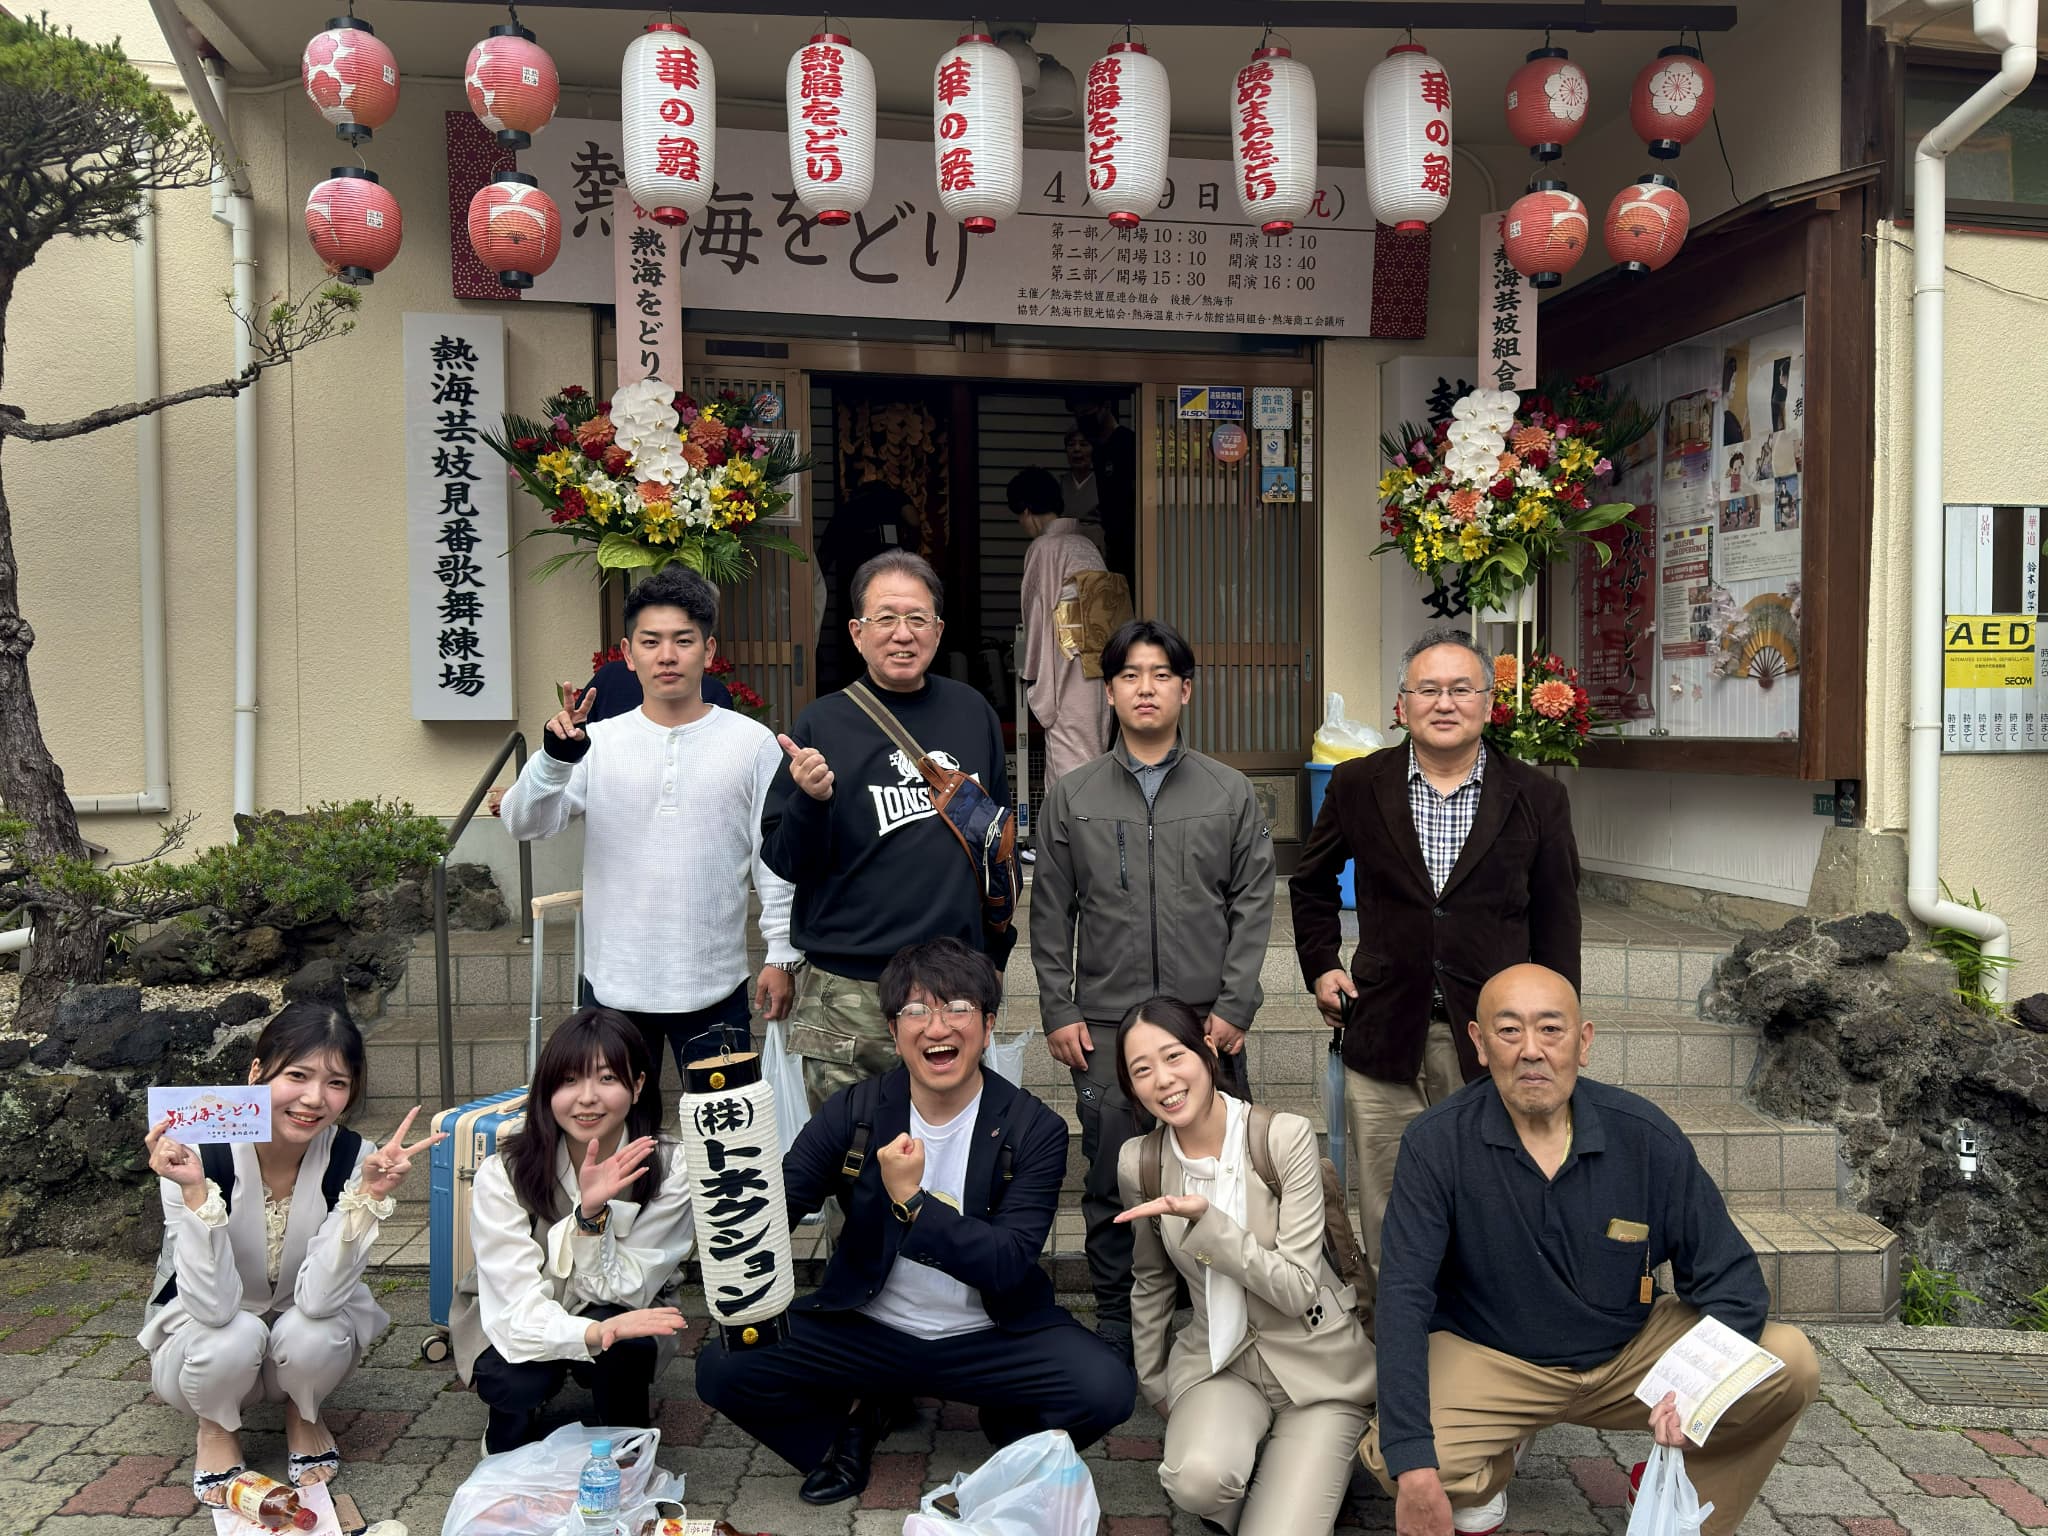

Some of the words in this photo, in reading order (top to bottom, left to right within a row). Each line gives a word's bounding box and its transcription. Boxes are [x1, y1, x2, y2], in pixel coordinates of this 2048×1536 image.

[800, 45, 848, 183] 熱海をどり
[1088, 57, 1124, 191] 熱海をどり
[628, 226, 667, 377] 熱海をどり
[428, 334, 486, 698] 熱海芸妓見番歌舞練場
[1949, 622, 2030, 646] AED
[2004, 676, 2032, 686] SECOM
[1947, 713, 1957, 743] 時まで
[1963, 713, 1972, 743] 時まで
[1978, 713, 1988, 743] 時まで
[1994, 712, 2004, 742] 時まで
[2009, 712, 2019, 742] 時まで
[2025, 712, 2034, 742] 時まで
